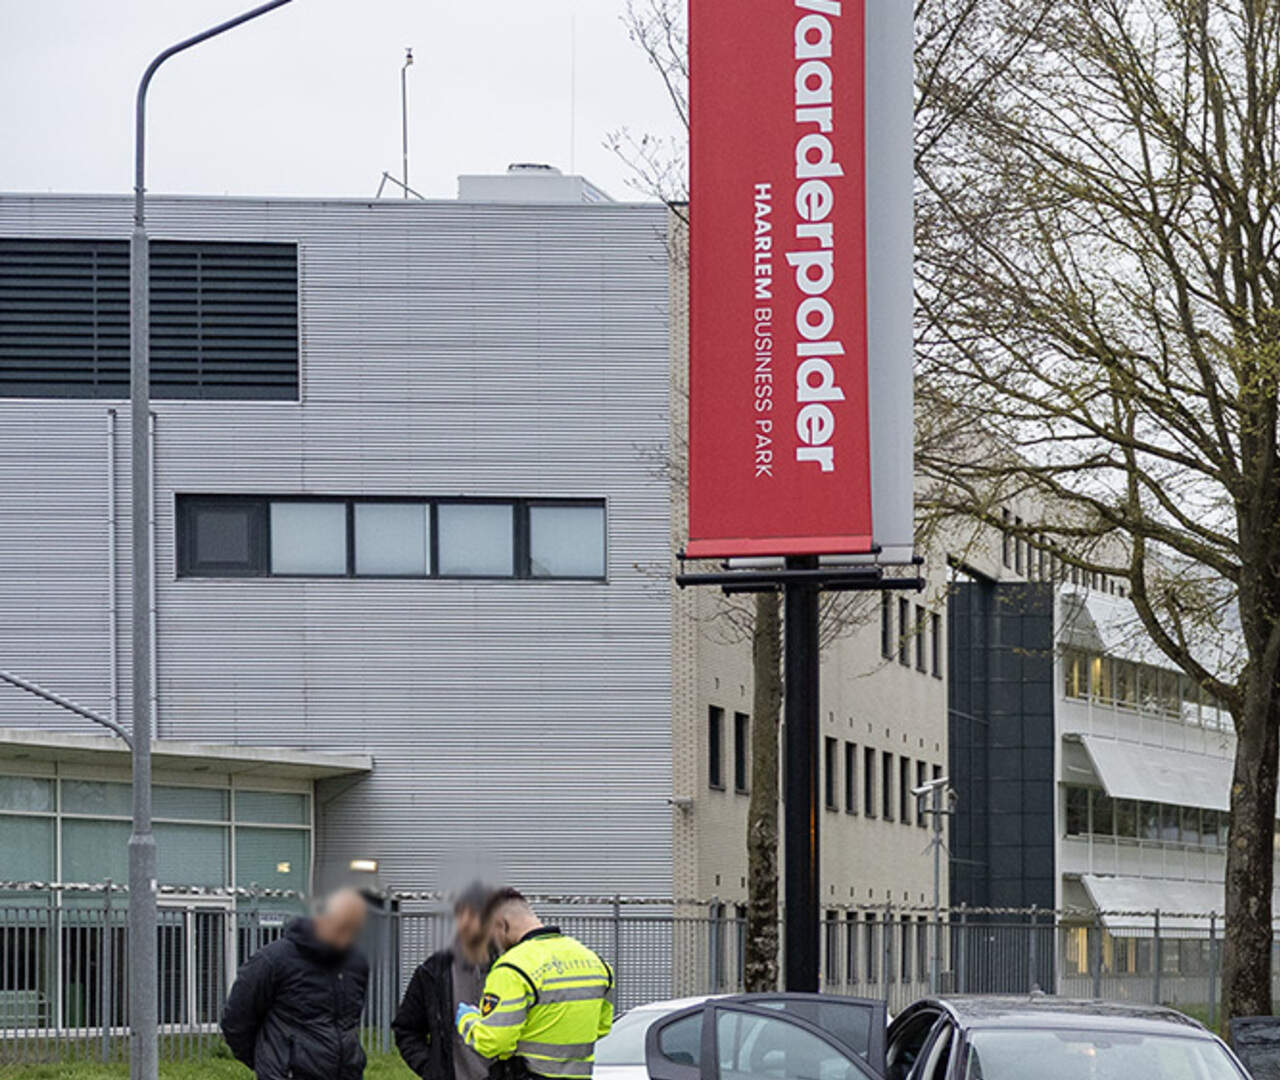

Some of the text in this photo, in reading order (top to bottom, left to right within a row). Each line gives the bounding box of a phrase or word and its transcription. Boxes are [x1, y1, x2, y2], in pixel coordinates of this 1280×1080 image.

[753, 183, 774, 477] HAARLEM BUSINESS PARK
